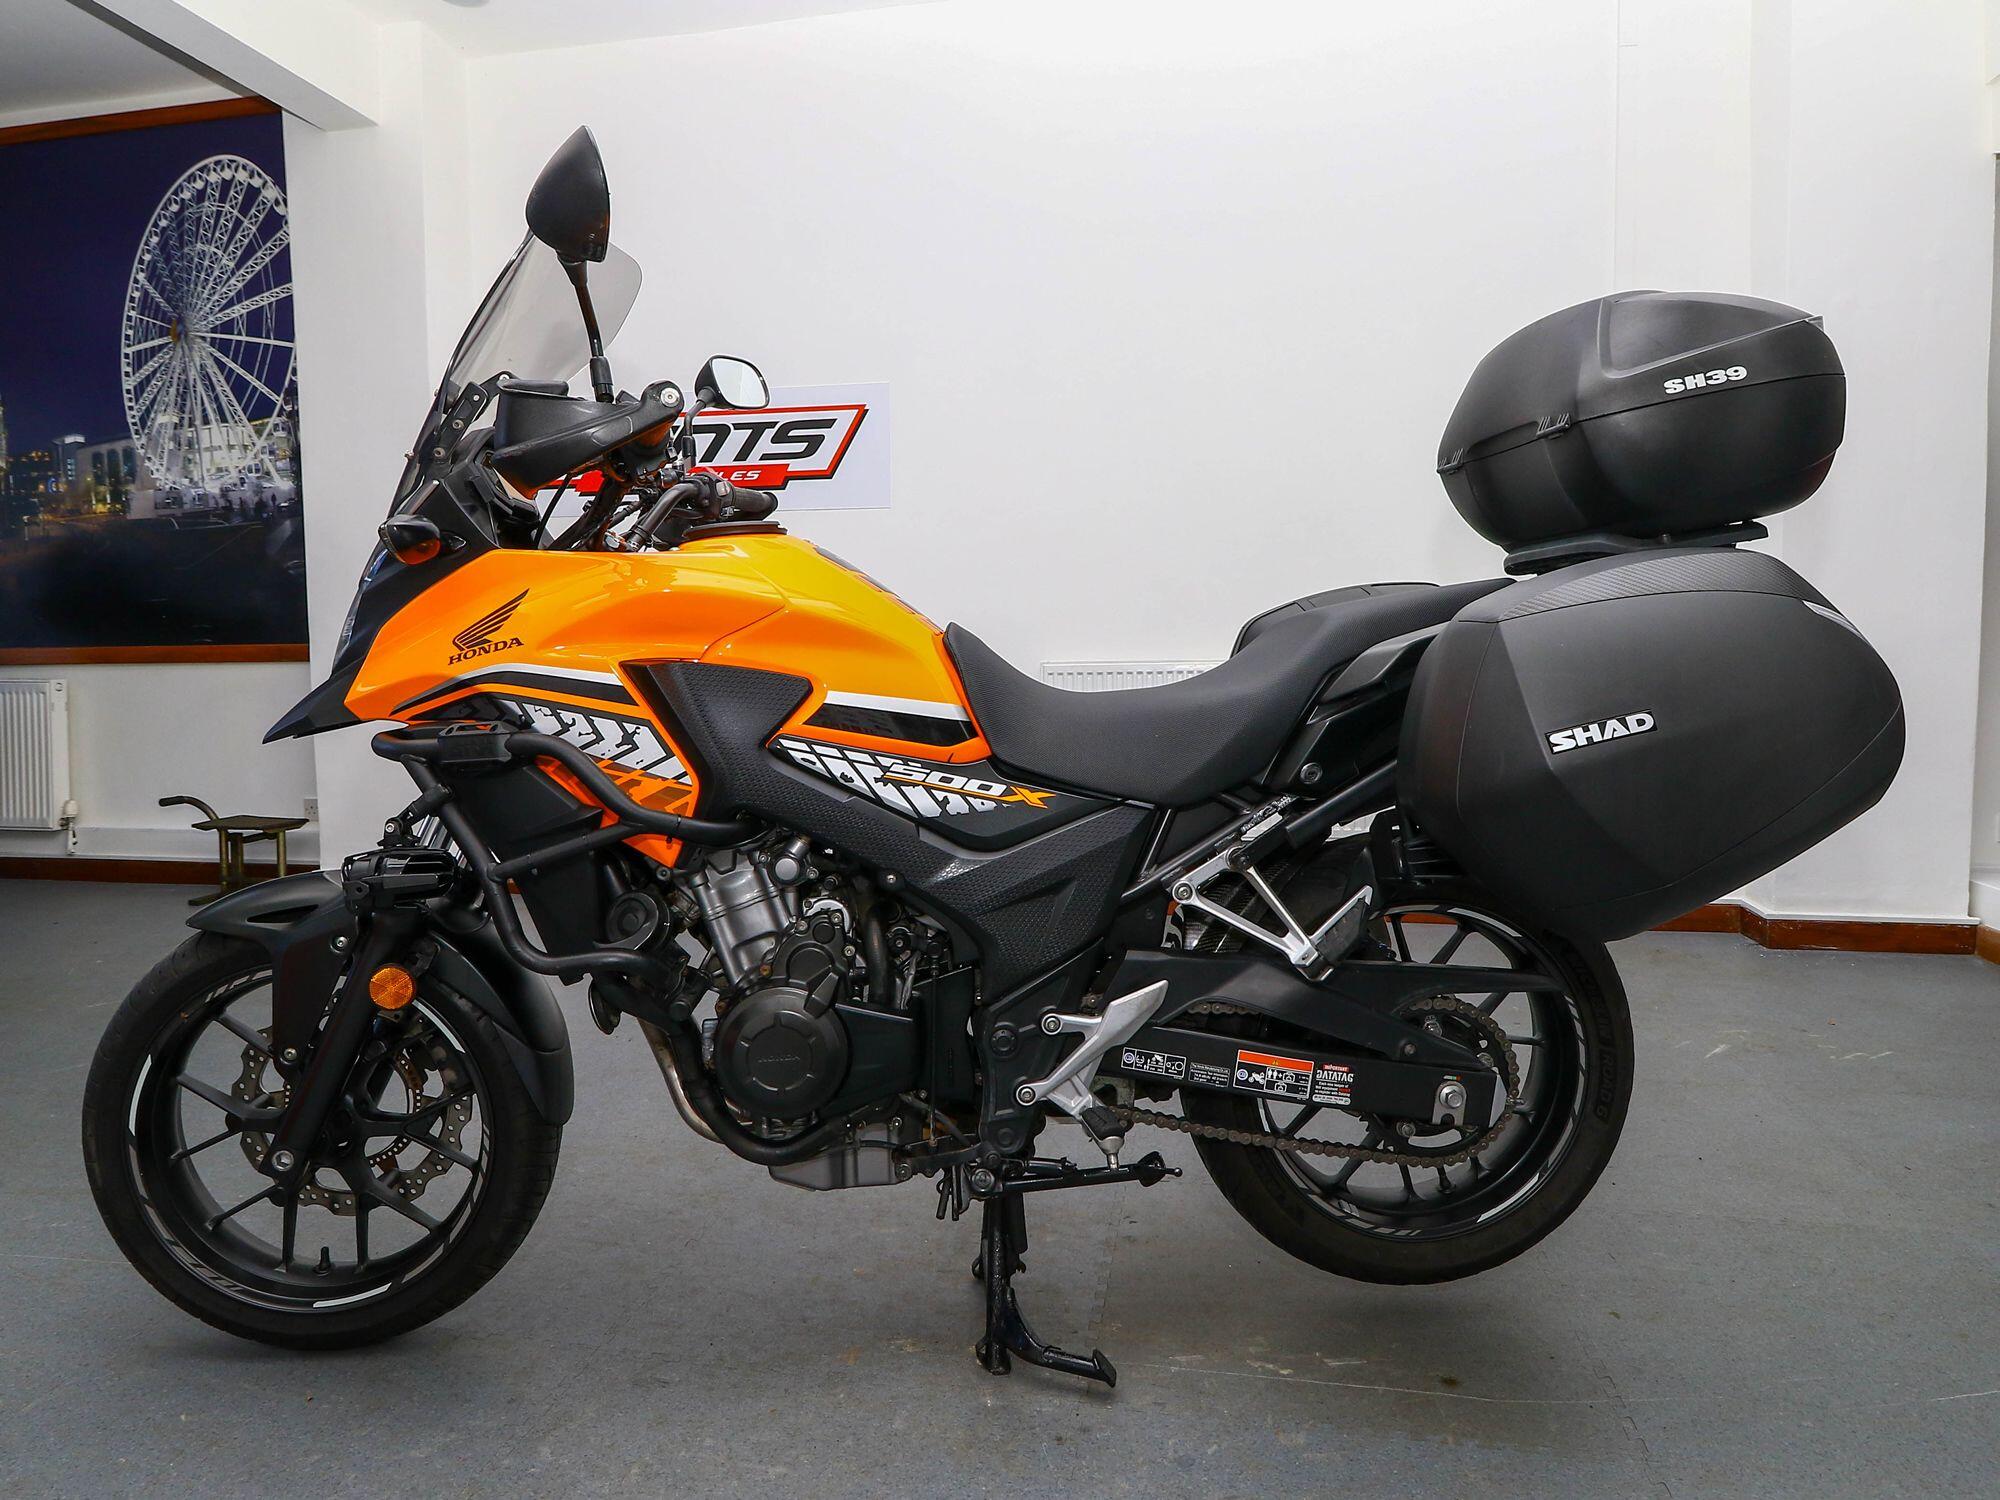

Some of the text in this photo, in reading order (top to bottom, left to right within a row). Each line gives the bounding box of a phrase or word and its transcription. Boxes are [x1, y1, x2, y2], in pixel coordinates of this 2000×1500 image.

[1663, 365, 1748, 394] SH39
[447, 637, 524, 665] HONDA
[1549, 713, 1655, 753] SHAD
[1316, 1069, 1354, 1083] DATATAG
